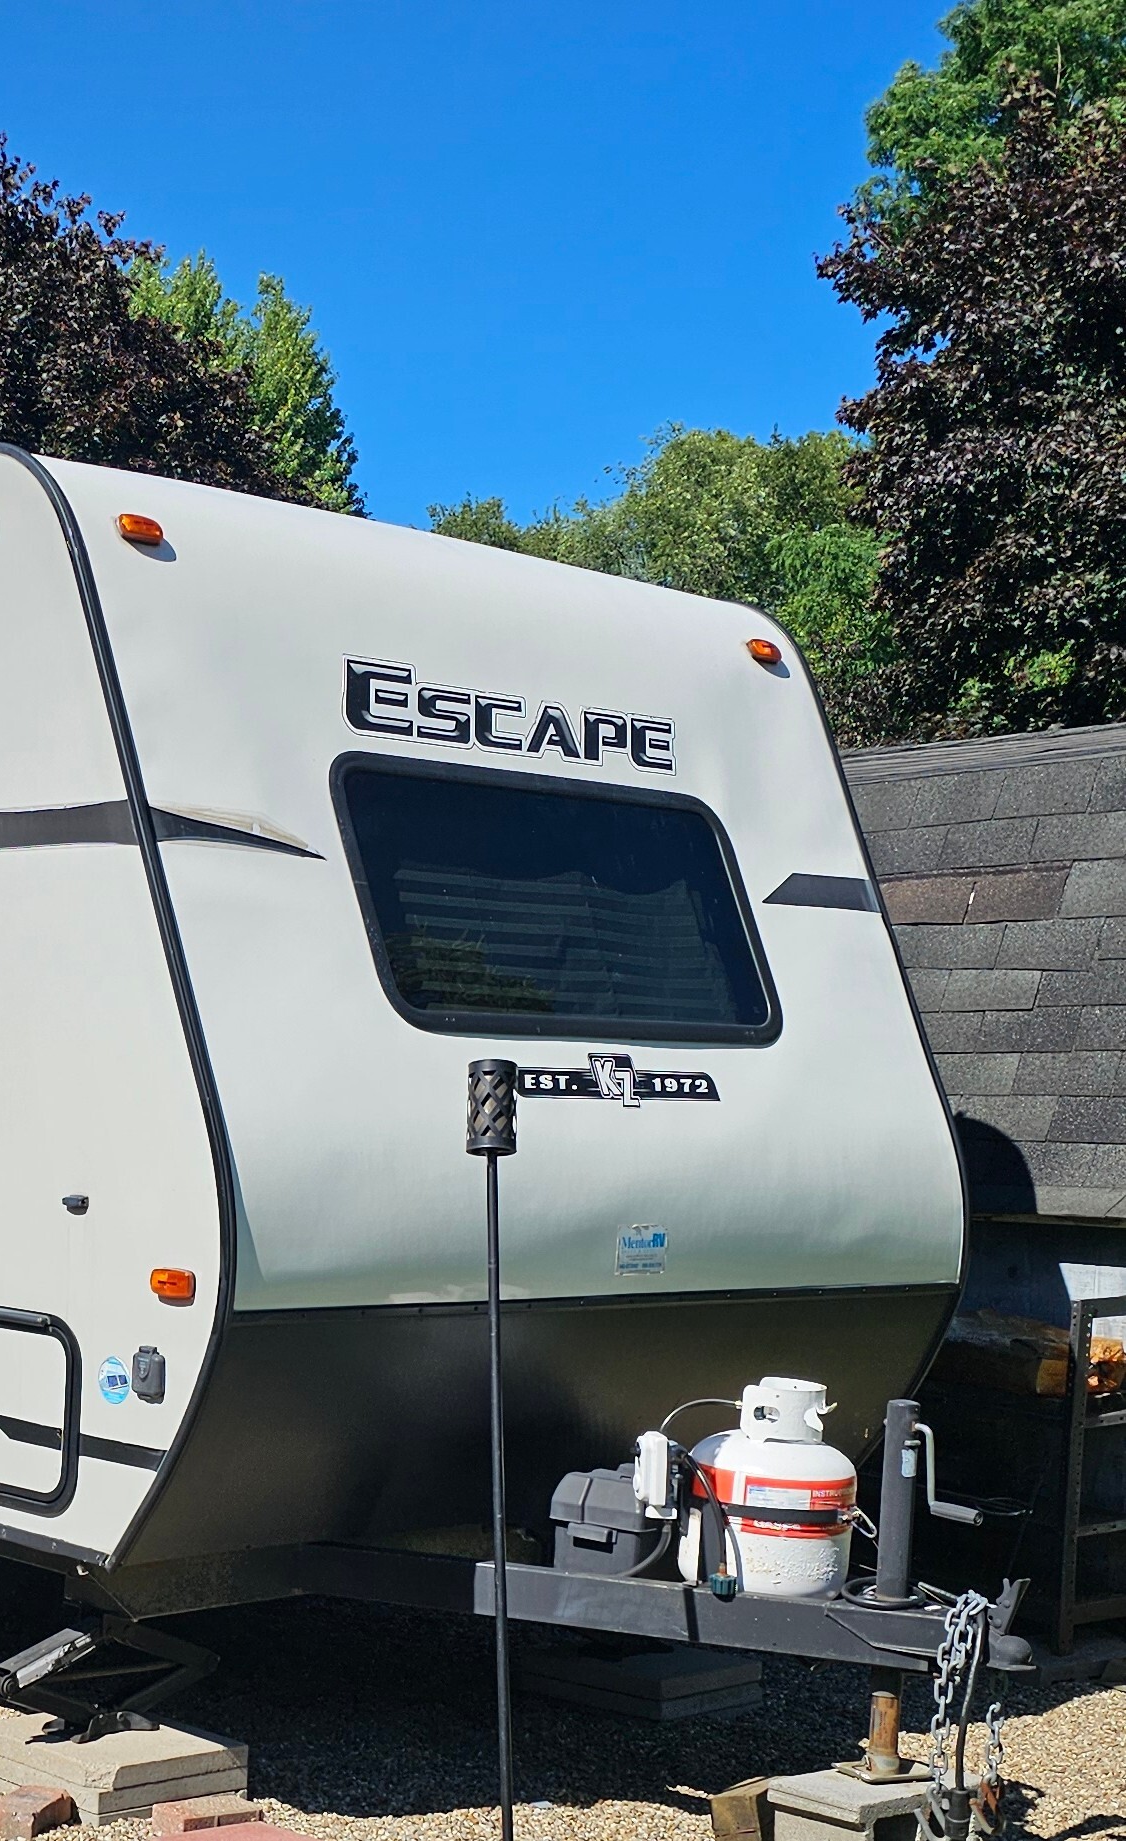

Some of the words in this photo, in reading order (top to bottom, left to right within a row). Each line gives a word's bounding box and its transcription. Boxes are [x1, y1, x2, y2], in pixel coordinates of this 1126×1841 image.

[343, 655, 675, 774] ESCAPE
[524, 1073, 578, 1091] EST.
[591, 1057, 640, 1107] KZ
[651, 1077, 710, 1093] 1972
